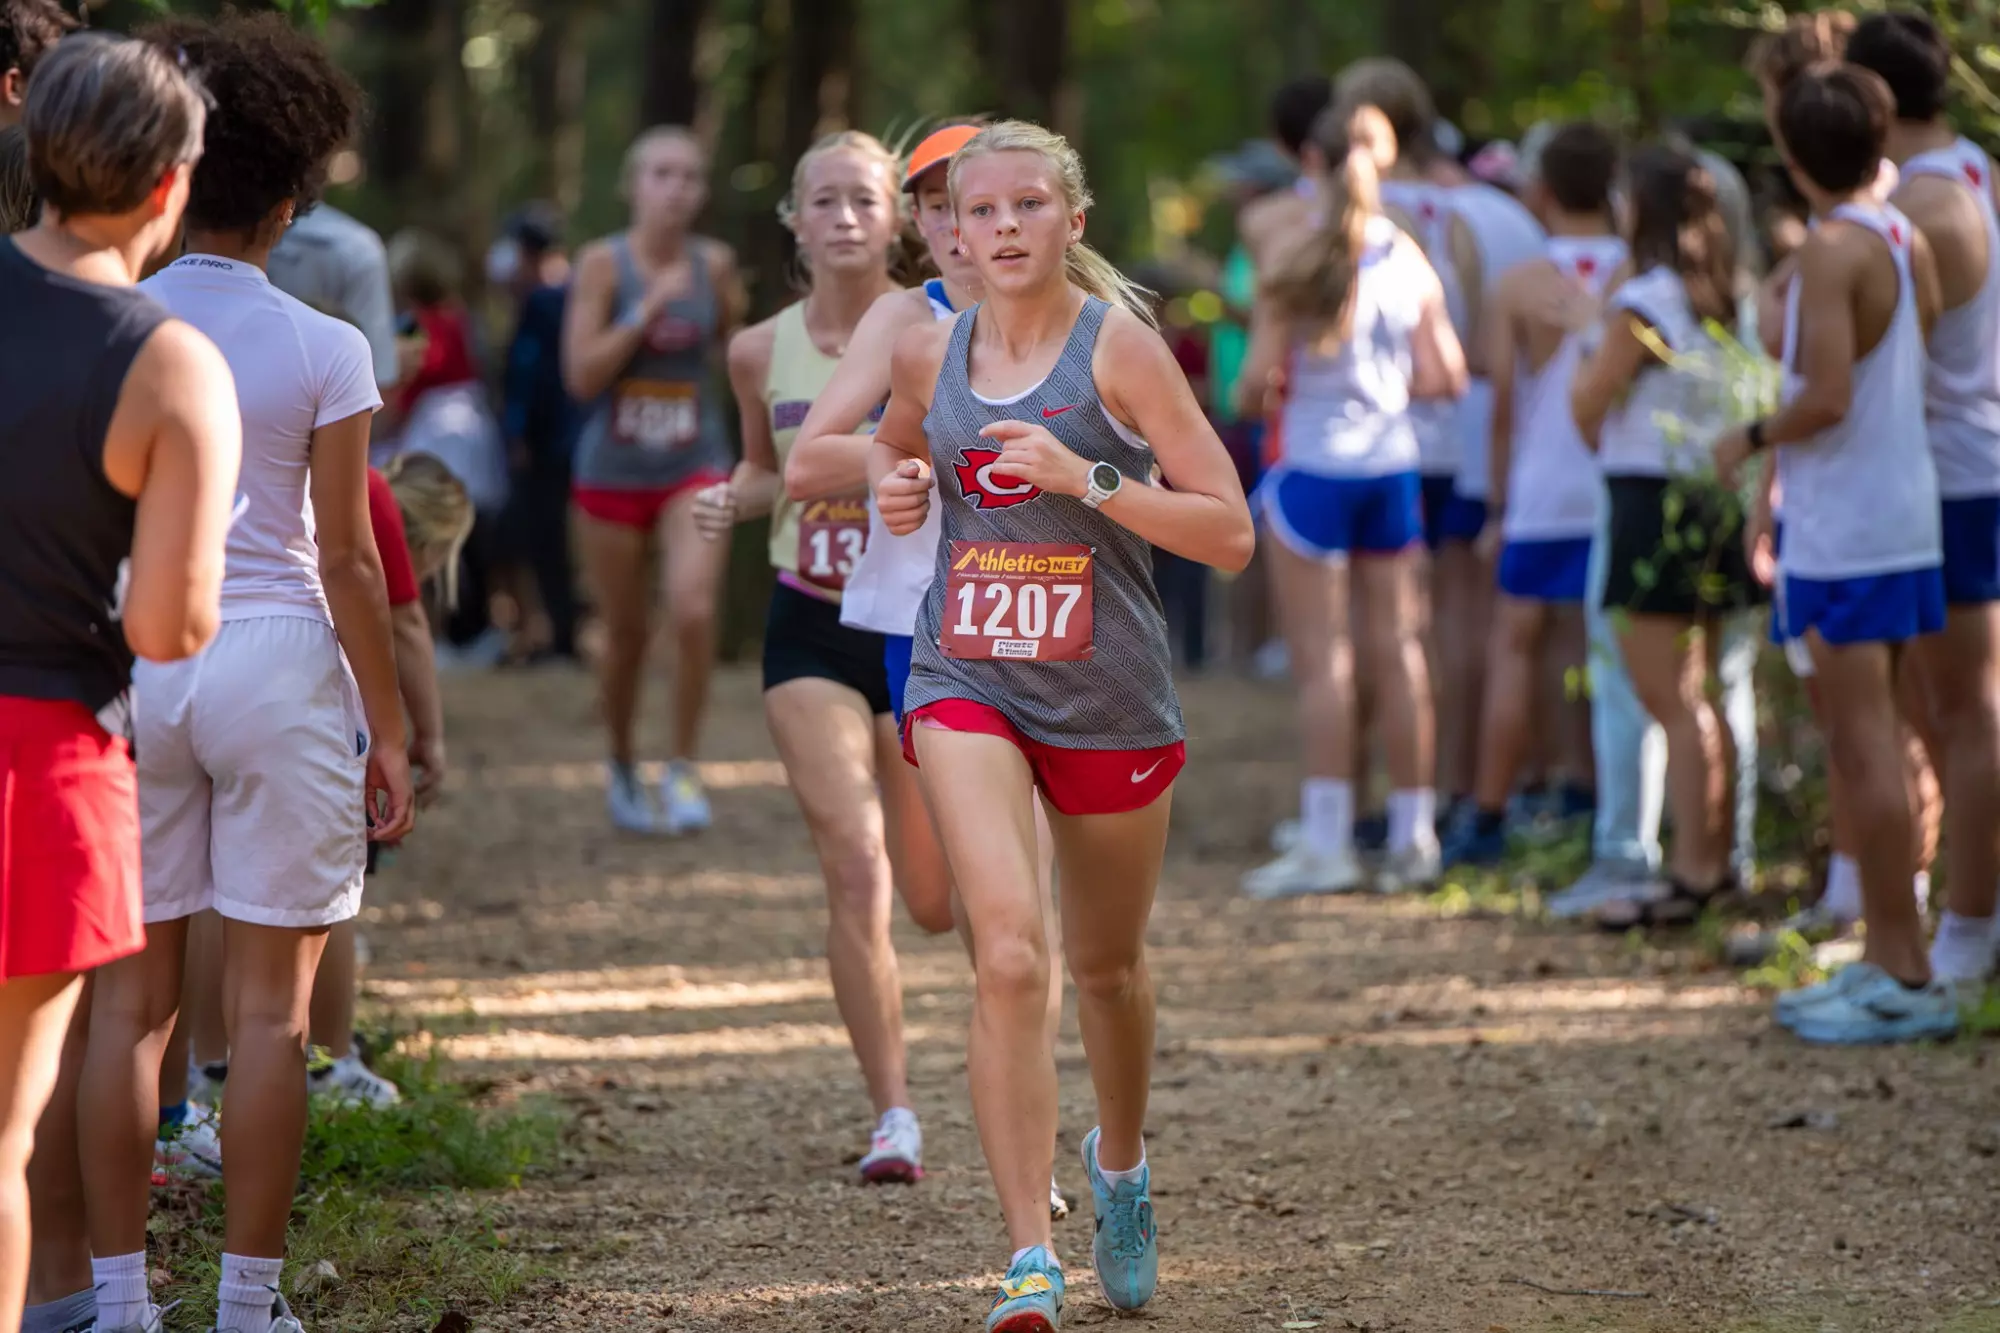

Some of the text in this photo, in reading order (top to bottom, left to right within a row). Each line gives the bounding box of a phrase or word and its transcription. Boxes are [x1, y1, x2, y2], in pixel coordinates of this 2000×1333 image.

[199, 258, 233, 270] PRO
[953, 547, 1050, 573] Athletic
[953, 582, 1082, 639] 1207
